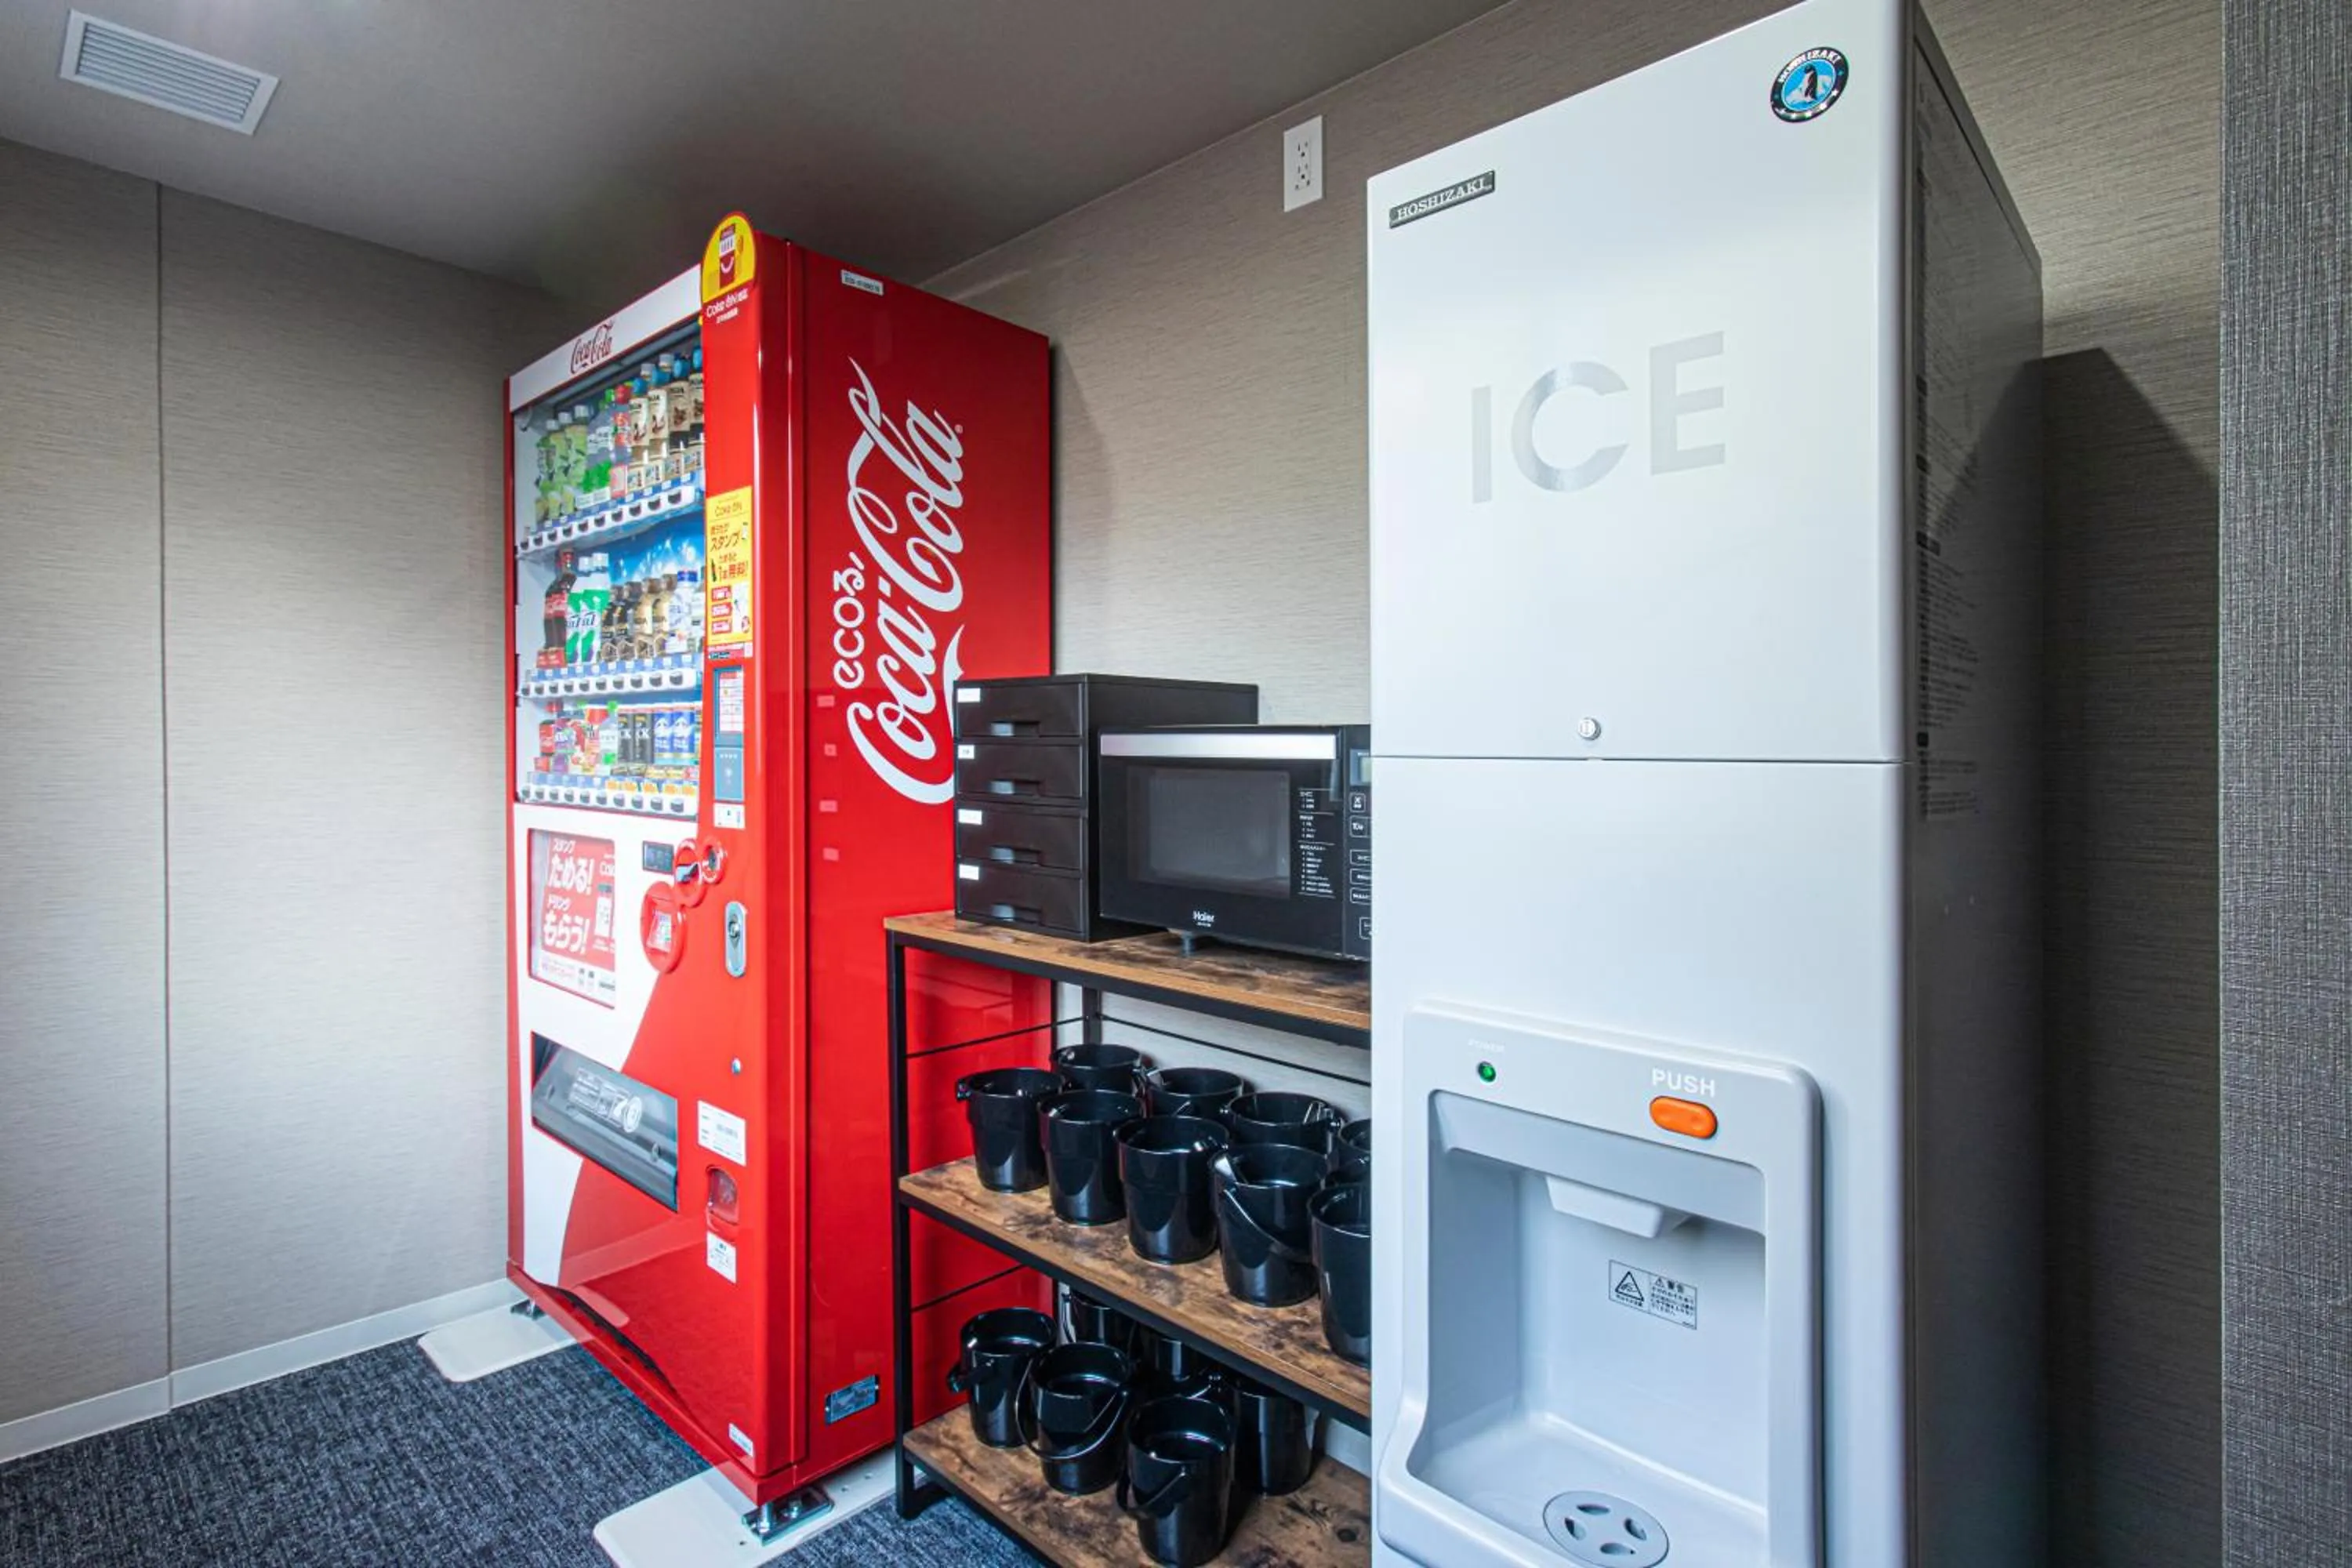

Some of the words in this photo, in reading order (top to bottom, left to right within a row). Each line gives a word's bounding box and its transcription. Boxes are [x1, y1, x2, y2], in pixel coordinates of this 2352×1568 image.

[1396, 176, 1490, 220] HOSHIZAKI
[570, 320, 615, 375] Coca-Cola
[1472, 330, 1726, 504] ICE
[846, 354, 965, 805] Coca-Cola
[1192, 910, 1214, 922] Haier
[1651, 1067, 1715, 1098] PUSH
